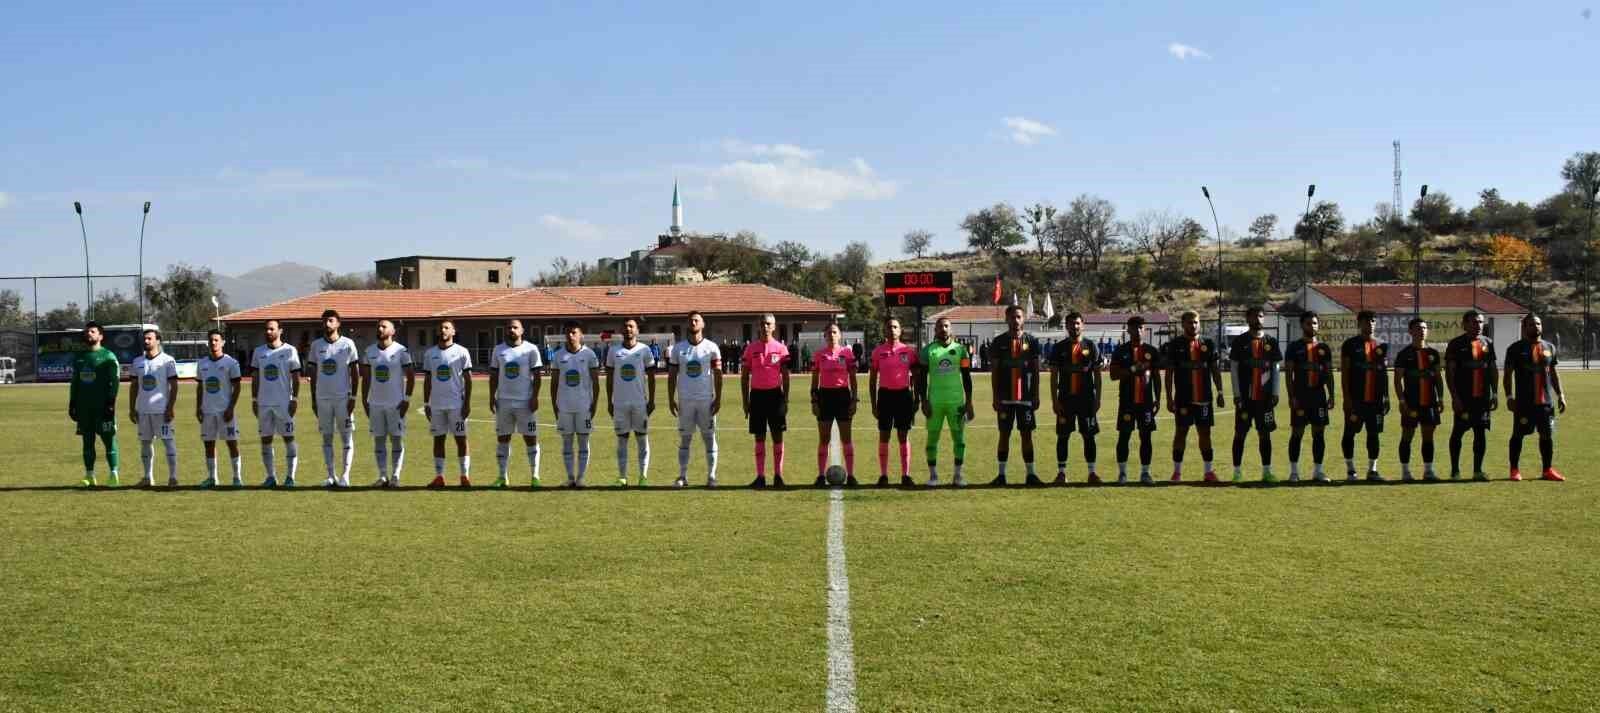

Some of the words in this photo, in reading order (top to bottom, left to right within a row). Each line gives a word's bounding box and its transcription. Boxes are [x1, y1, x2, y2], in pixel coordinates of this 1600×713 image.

[898, 294, 905, 305] 0
[939, 293, 946, 305] 0
[456, 421, 465, 432] 20
